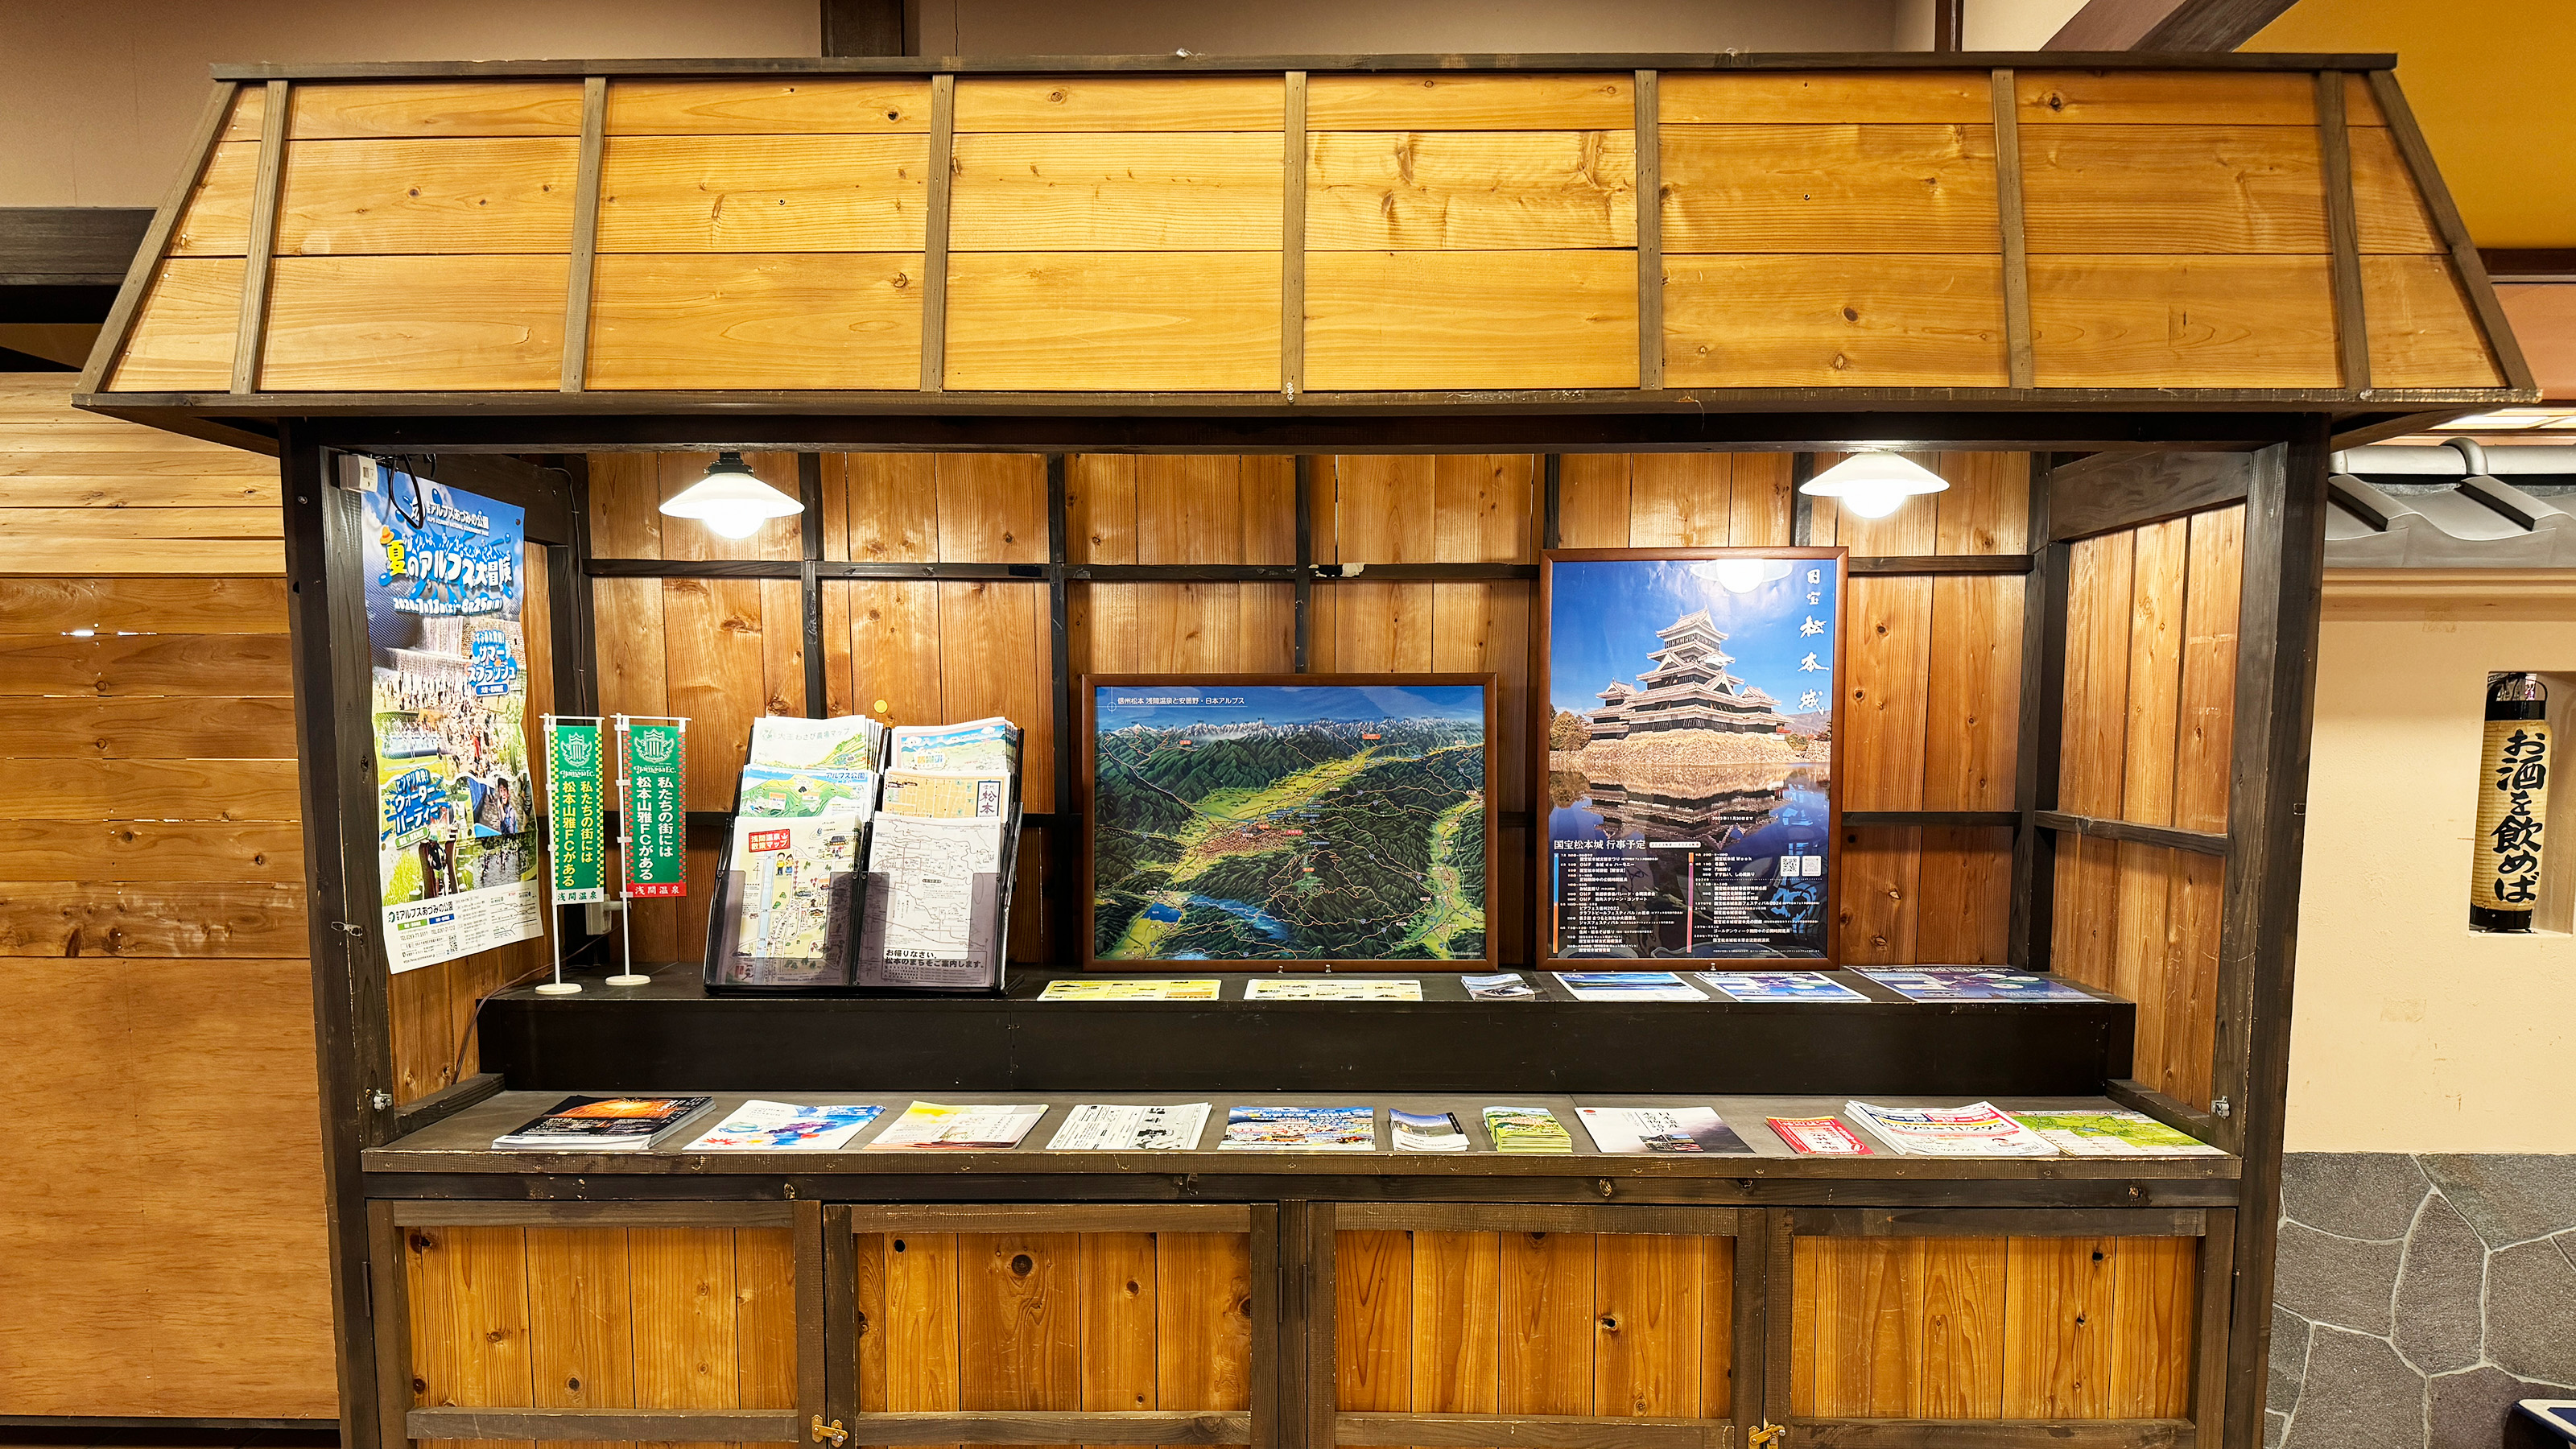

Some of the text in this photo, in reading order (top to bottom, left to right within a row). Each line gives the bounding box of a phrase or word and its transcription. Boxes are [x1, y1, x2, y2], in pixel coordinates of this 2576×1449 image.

[386, 539, 514, 590] 夏のアルプス大冒険
[479, 646, 505, 663] サマー
[467, 663, 515, 682] スプラッシュ
[1118, 697, 1144, 705] 信州松本
[394, 785, 436, 813] ウォーター
[396, 806, 438, 833] パーティー
[580, 781, 593, 863] 私たちの街には
[636, 776, 654, 881] 松本山雅FCがある
[658, 777, 674, 857] 私たちの街には
[2490, 729, 2546, 903] お酒を飲めば
[562, 781, 576, 886] 松本山雅FCがある
[1554, 839, 1604, 849] 国宝松本城
[1606, 839, 1646, 849] 行事予定
[557, 890, 597, 902] 浅間温泉
[635, 885, 680, 895] 浅間温泉
